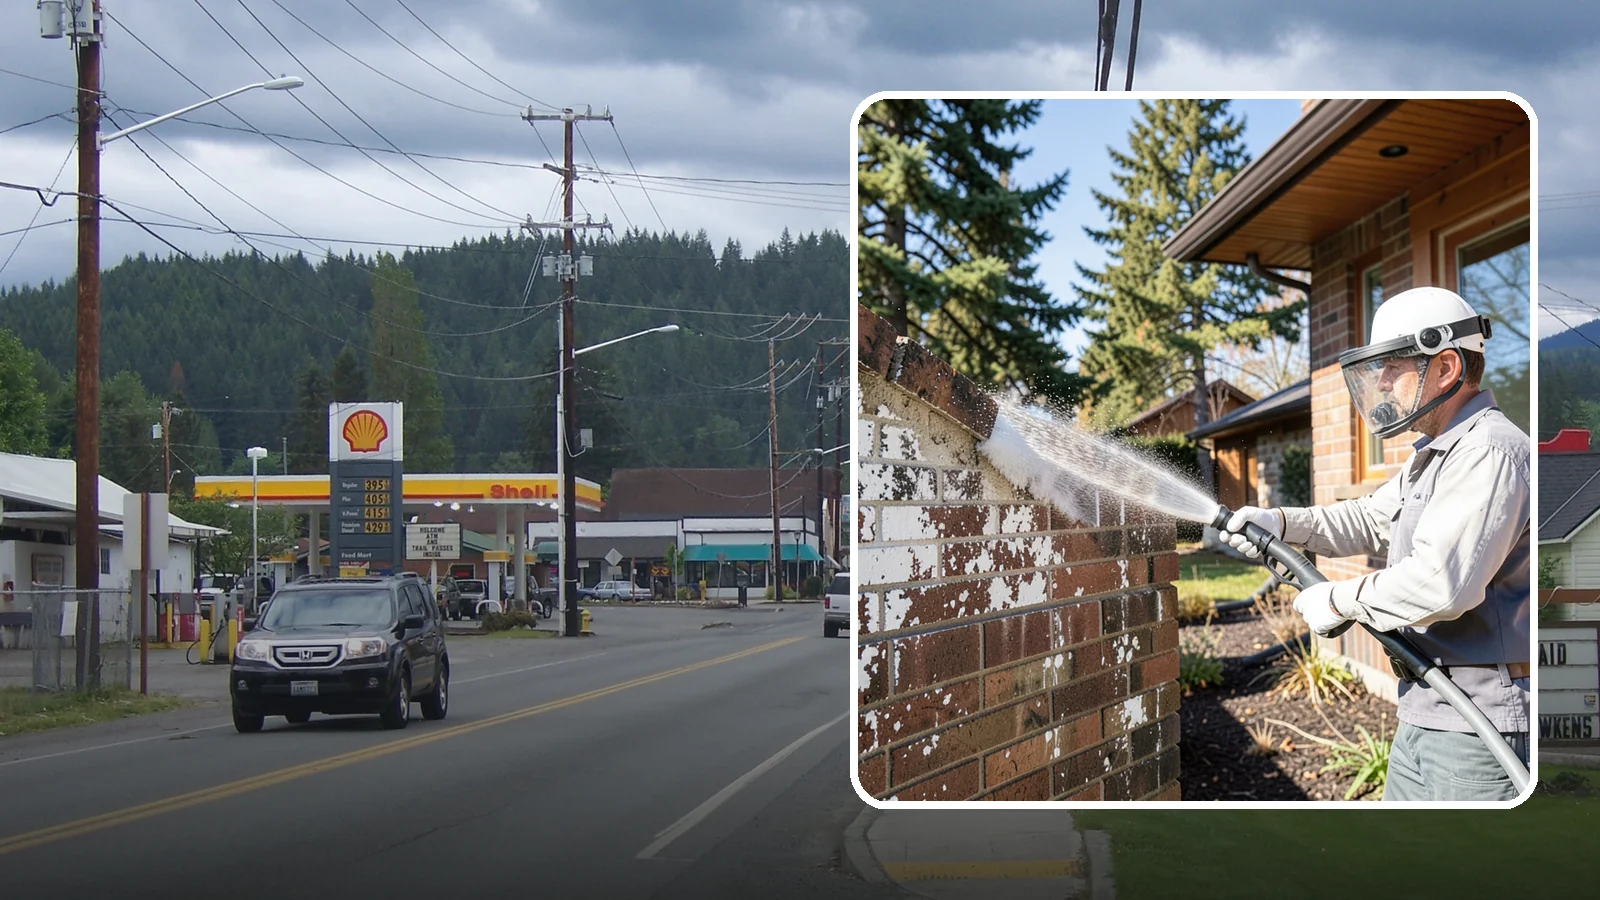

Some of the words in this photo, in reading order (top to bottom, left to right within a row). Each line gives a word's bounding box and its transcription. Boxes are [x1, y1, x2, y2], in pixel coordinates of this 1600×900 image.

[366, 480, 383, 490] 395
[490, 484, 547, 499] Shell
[366, 494, 383, 504] 405
[366, 508, 383, 518] 415
[366, 522, 383, 532] 429
